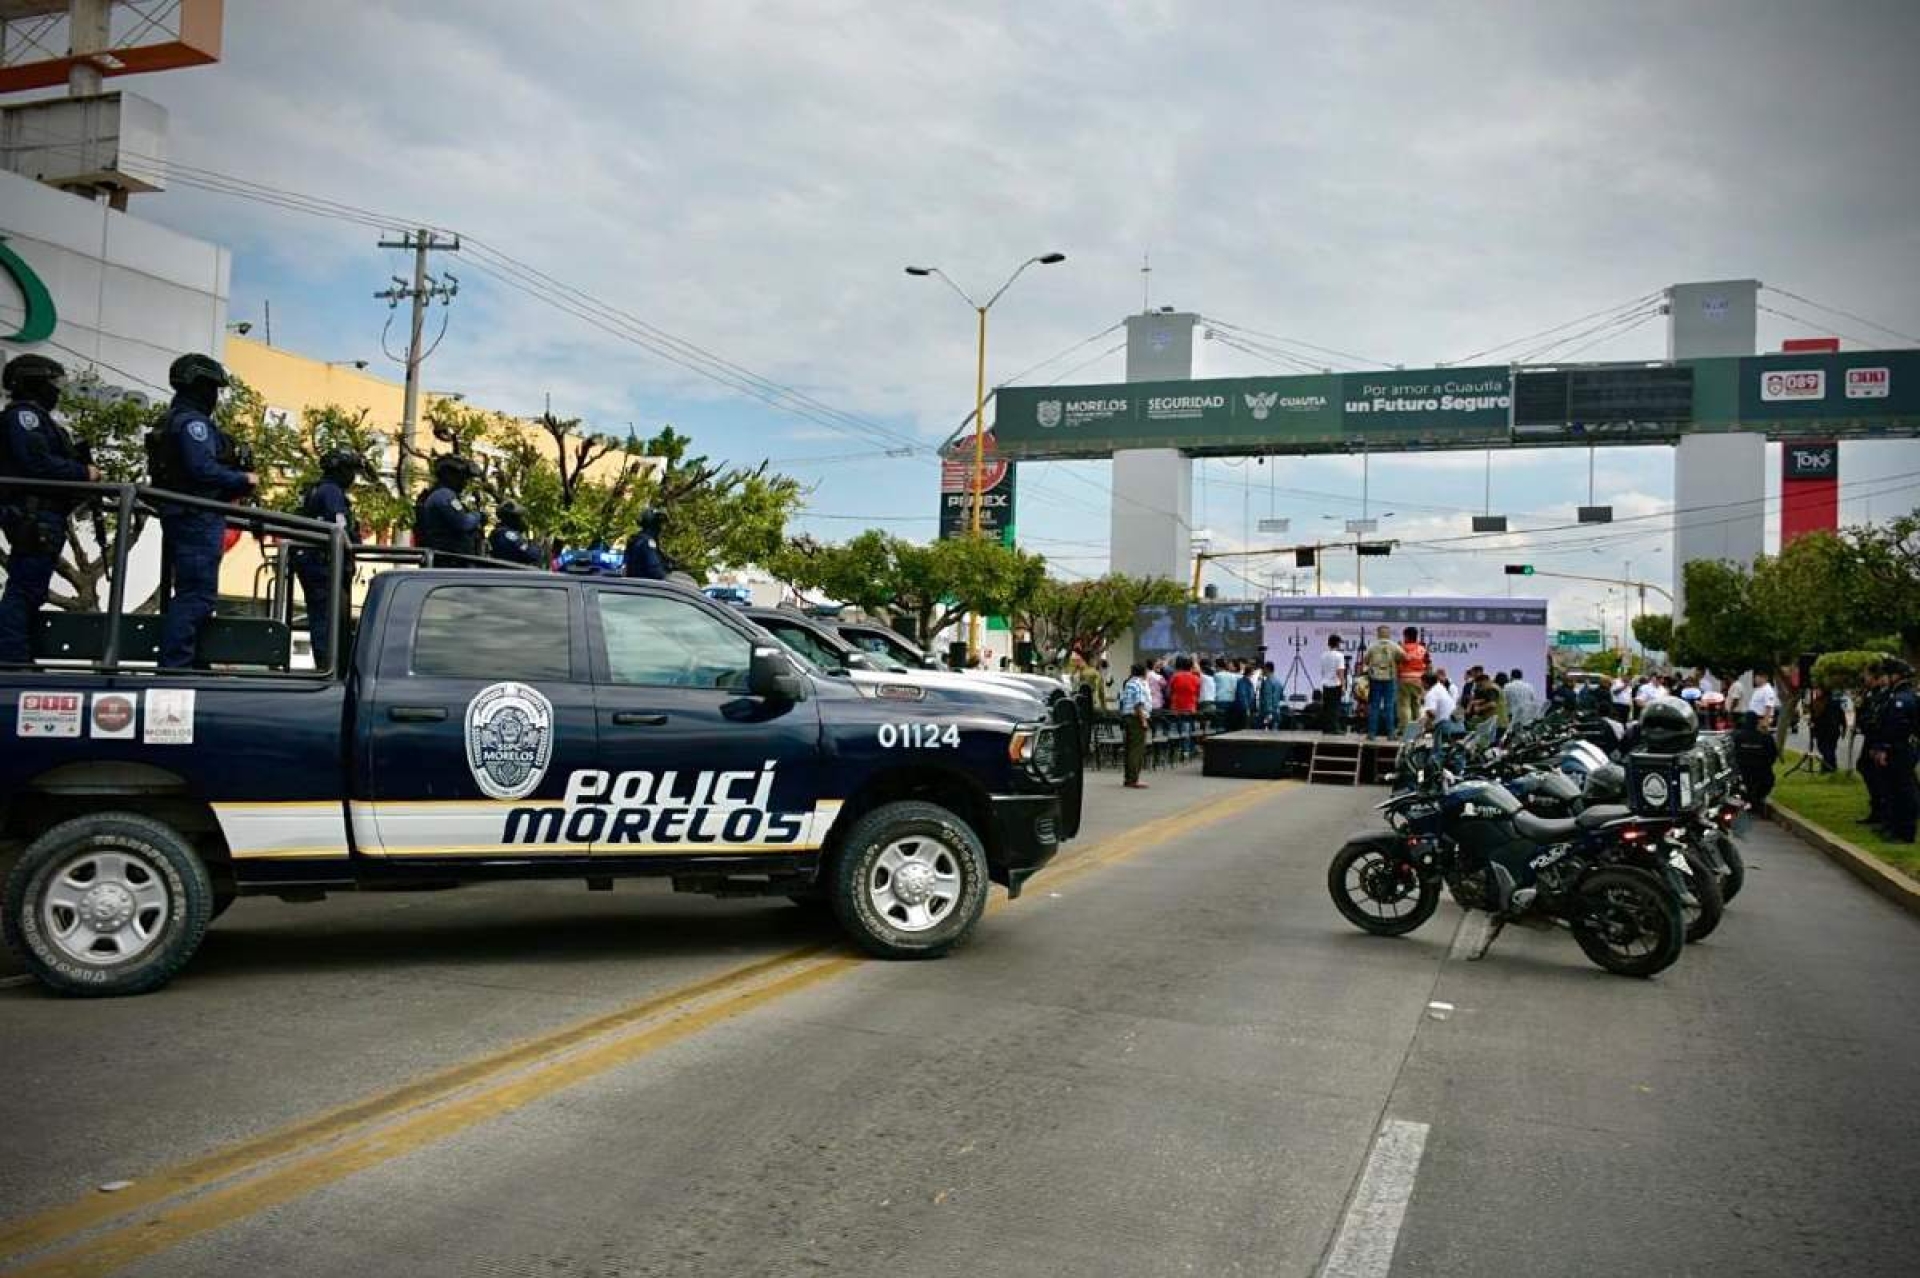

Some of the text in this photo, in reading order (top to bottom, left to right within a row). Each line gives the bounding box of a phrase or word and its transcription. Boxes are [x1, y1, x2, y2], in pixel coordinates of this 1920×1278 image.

[1363, 384, 1386, 396] Por
[1391, 384, 1430, 396] amor
[1444, 381, 1502, 394] Cuautla
[1066, 400, 1127, 412] MORELOS
[1148, 396, 1224, 411] SEGURIDAD
[1279, 396, 1327, 407] CUAUTLA
[1345, 394, 1510, 412] un Futuro Seguro
[878, 722, 960, 748] 01124
[484, 752, 534, 760] MORELOS
[503, 807, 808, 844] MORELOS
